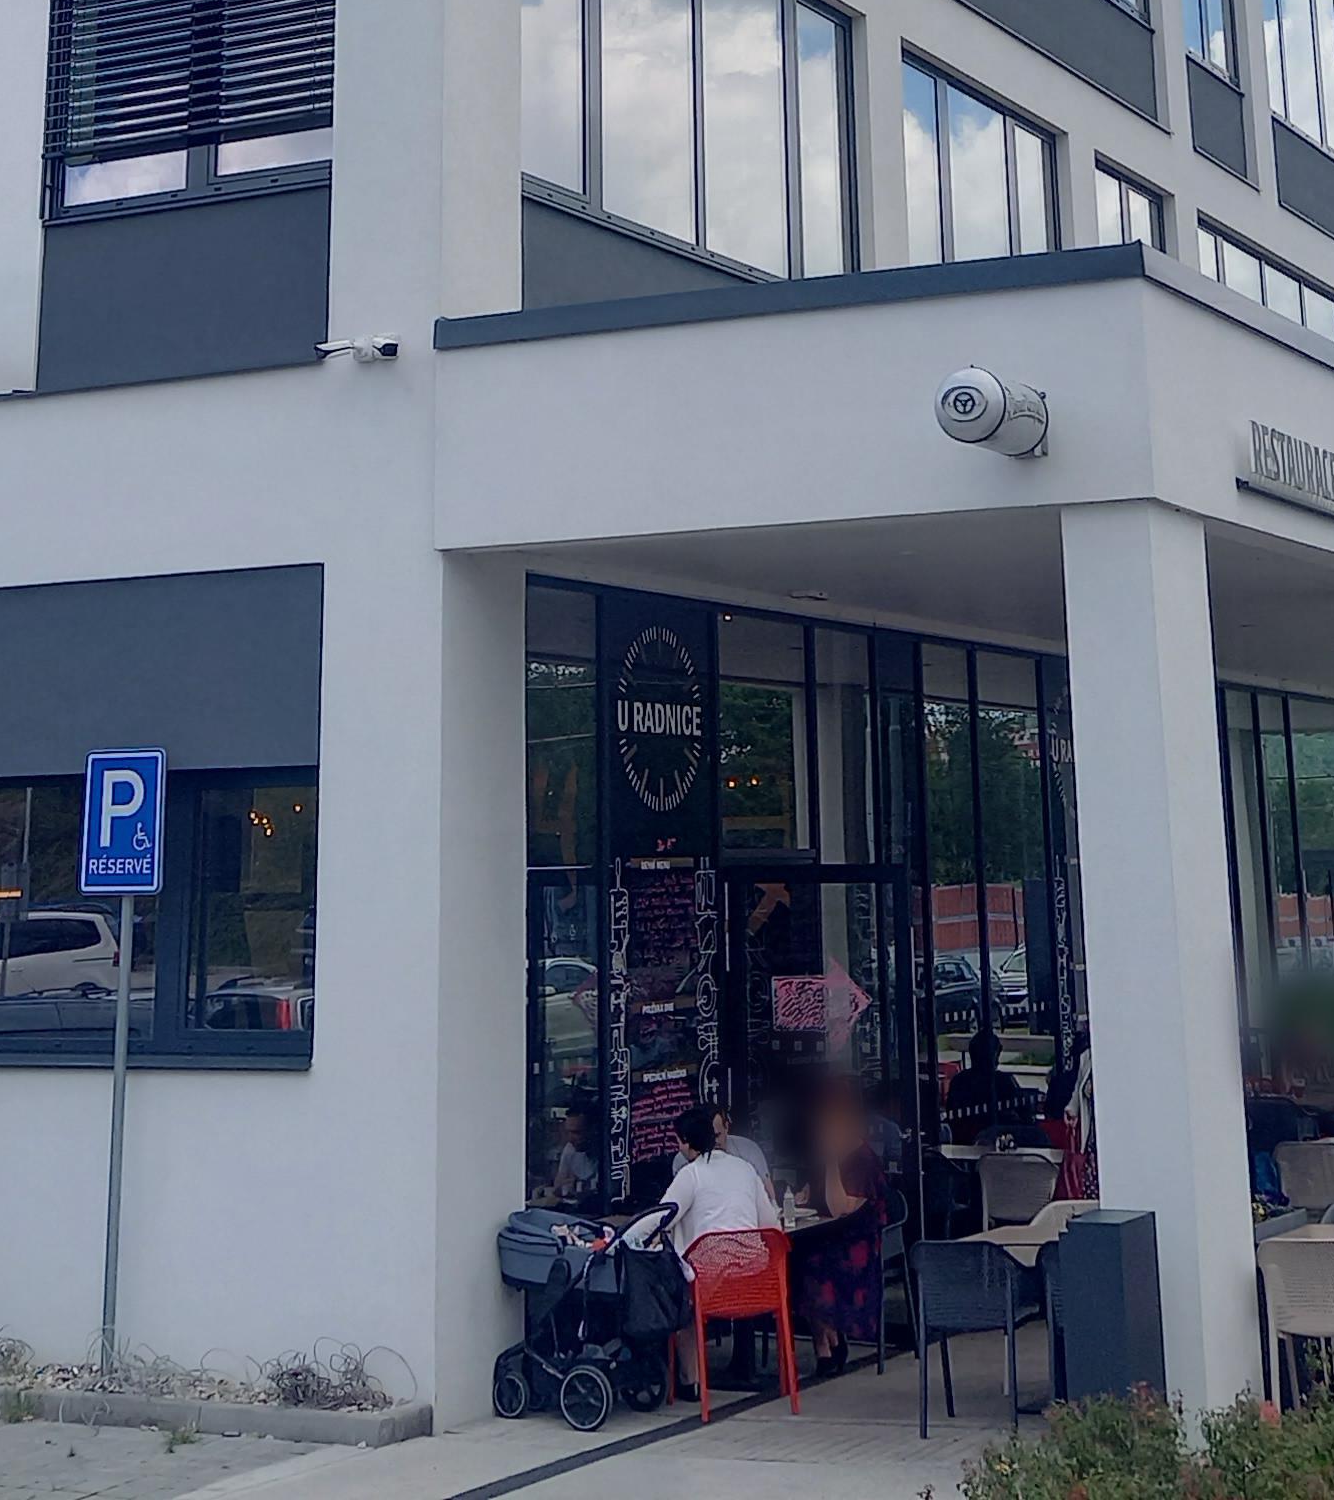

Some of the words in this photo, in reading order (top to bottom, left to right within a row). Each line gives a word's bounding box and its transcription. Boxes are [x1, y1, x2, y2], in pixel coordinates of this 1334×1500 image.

[617, 700, 629, 732] U
[633, 701, 702, 736] RADNICE
[100, 769, 145, 848] P
[88, 854, 152, 875] RÉSERVÉ
